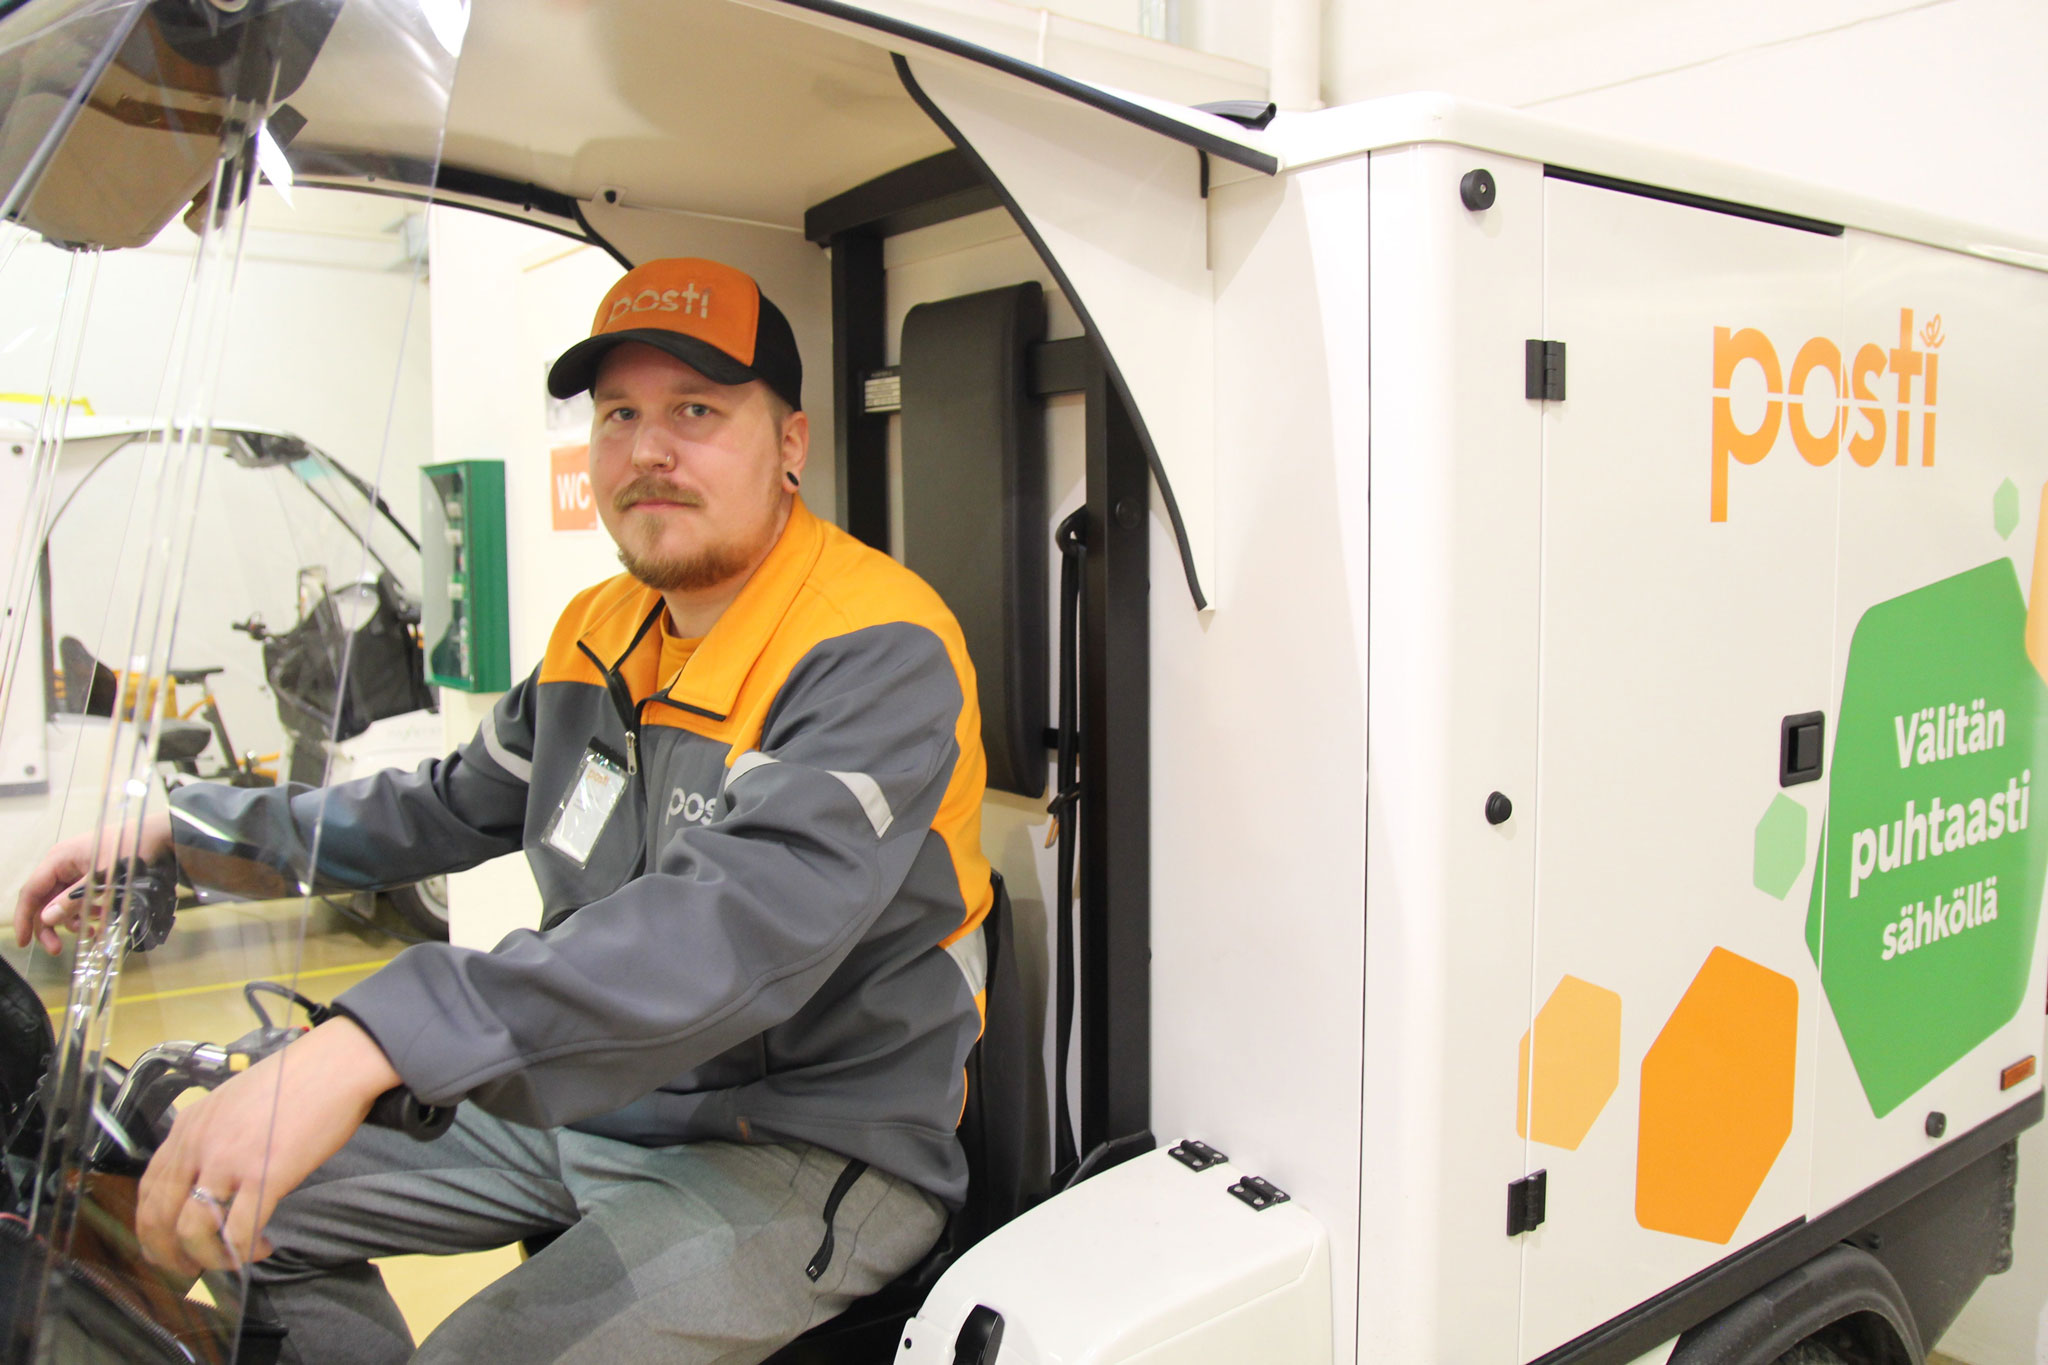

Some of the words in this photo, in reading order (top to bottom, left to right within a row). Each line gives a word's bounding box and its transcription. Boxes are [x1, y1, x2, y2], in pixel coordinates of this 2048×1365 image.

[607, 282, 711, 325] posti
[1710, 307, 1945, 523] posti
[556, 471, 591, 511] WC
[1894, 698, 2006, 769] Välitän
[665, 785, 718, 826] pos
[1849, 768, 2031, 899] puhtaasti
[1881, 875, 1998, 961] sähköllä
